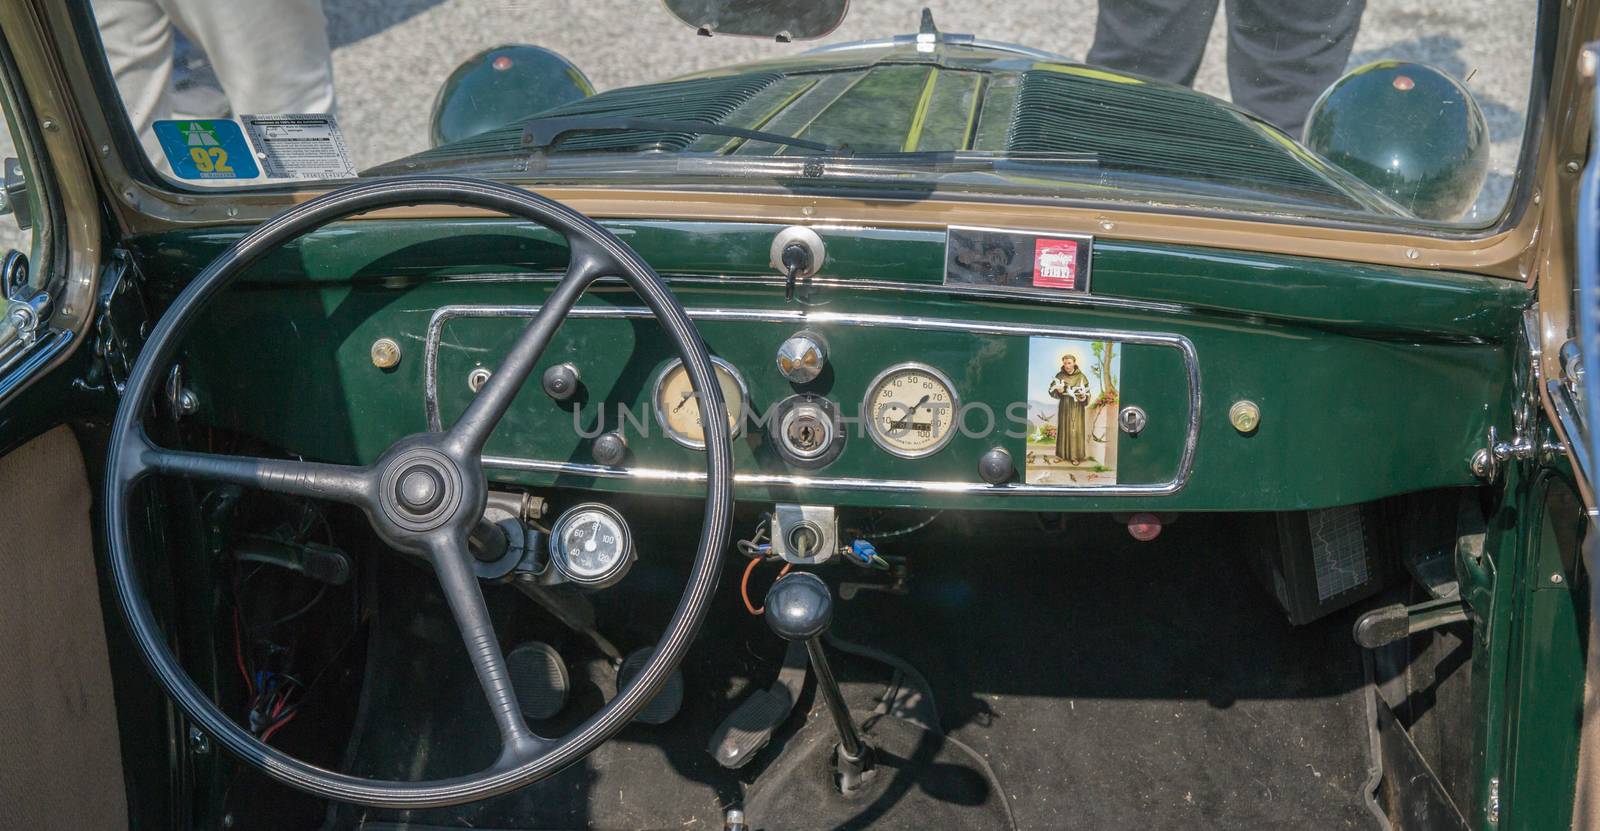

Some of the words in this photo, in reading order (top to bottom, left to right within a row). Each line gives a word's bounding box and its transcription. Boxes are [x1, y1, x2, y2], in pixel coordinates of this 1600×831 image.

[190, 147, 234, 172] 92
[907, 376, 918, 384] 50
[933, 393, 943, 401] 70
[882, 416, 892, 424] 10
[917, 430, 930, 438] 100
[592, 522, 602, 531] 80
[574, 529, 584, 538] 60
[602, 535, 614, 544] 100
[570, 548, 580, 557] 40
[598, 552, 610, 562] 120
